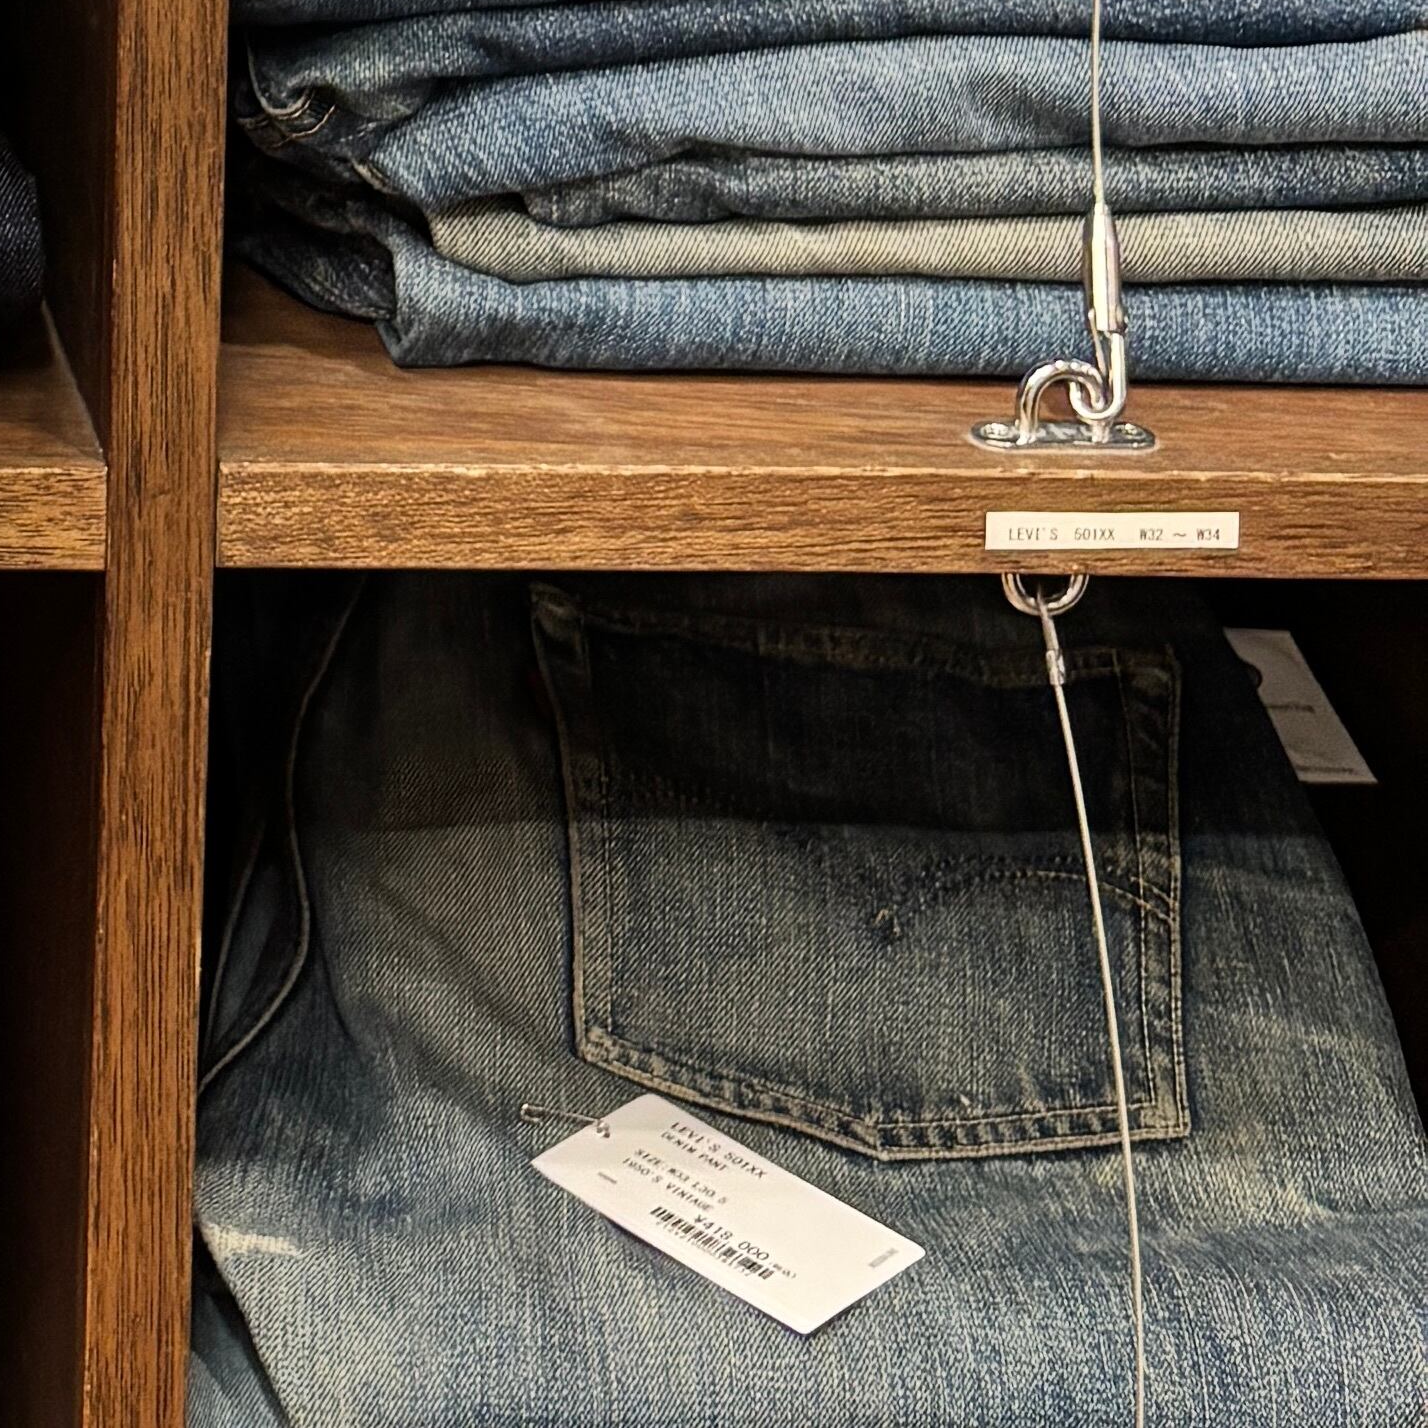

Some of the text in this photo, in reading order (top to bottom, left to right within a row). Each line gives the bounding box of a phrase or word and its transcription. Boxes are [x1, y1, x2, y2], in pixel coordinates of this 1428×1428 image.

[1008, 527, 1059, 541] LEVI'S
[1139, 527, 1164, 541] W32
[1196, 527, 1221, 541] W34
[670, 1122, 768, 1180] LEVI'S 501XX
